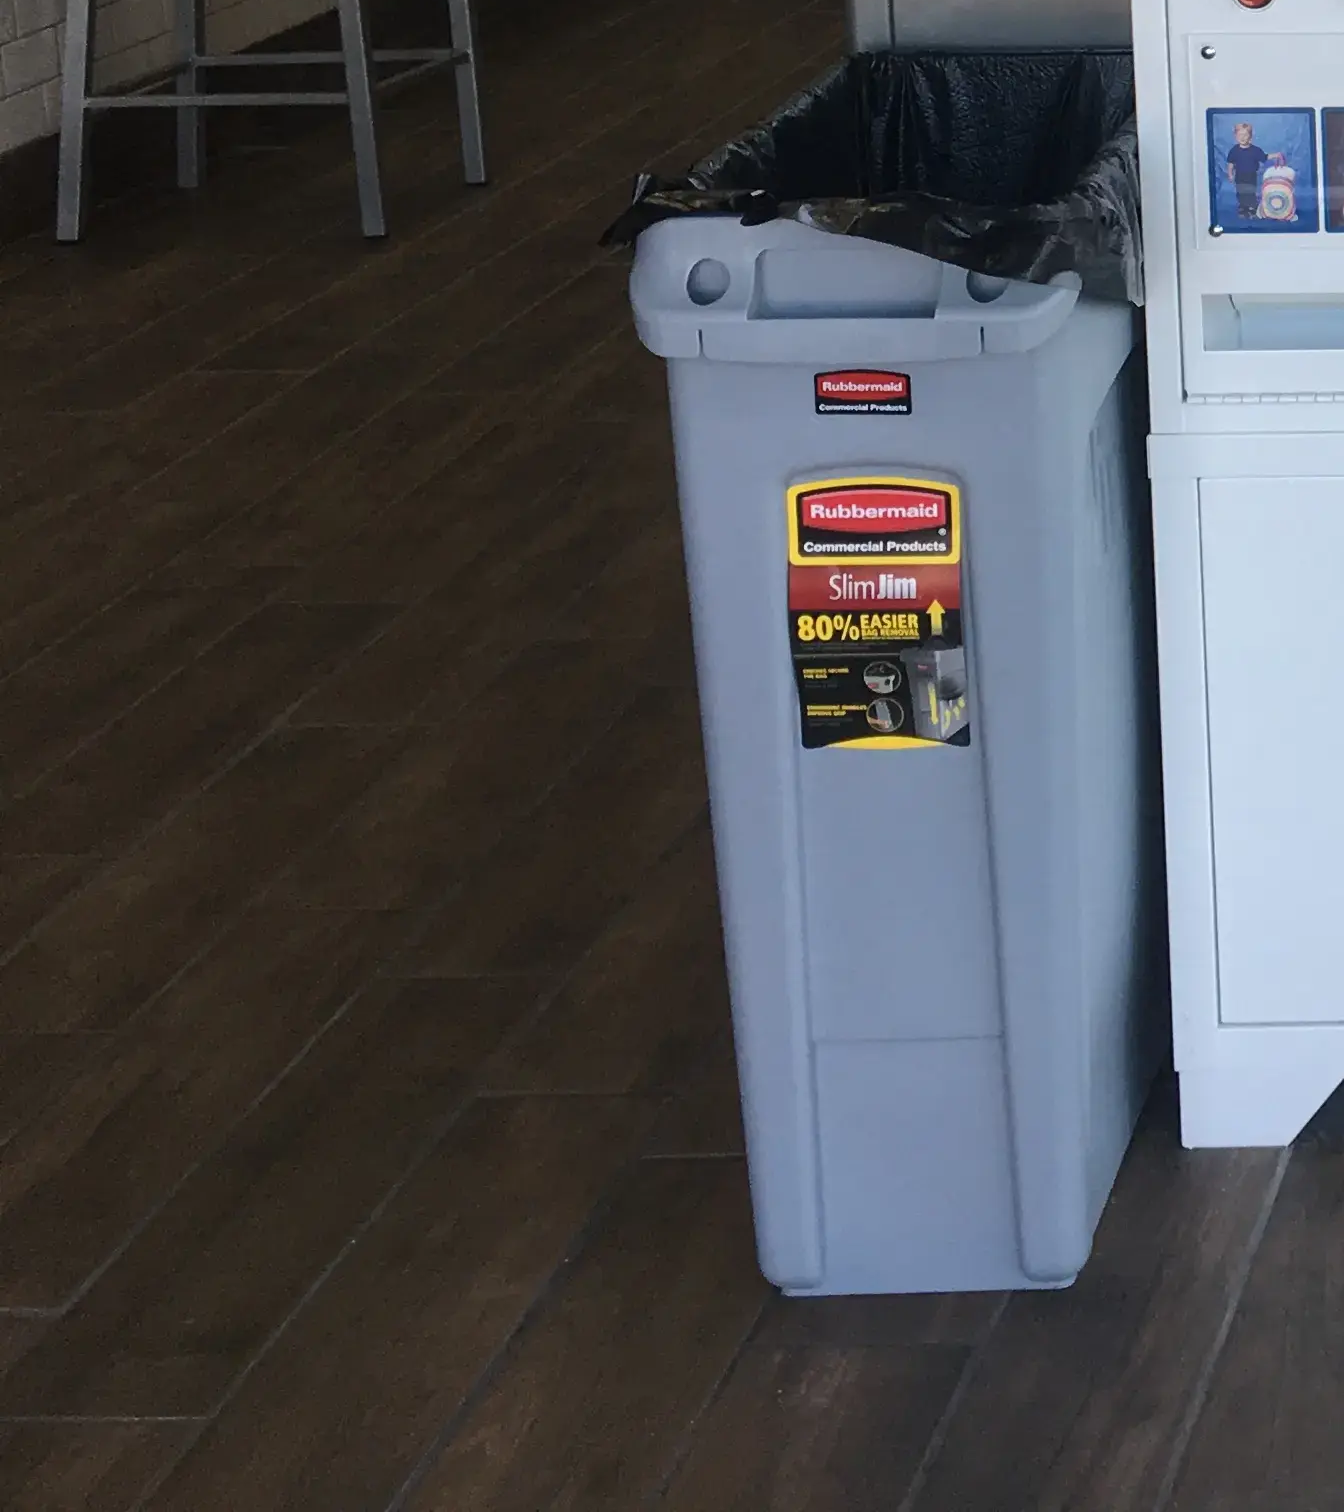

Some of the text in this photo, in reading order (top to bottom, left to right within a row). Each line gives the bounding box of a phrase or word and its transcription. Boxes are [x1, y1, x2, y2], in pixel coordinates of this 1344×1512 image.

[822, 381, 903, 392] Rubbermaid
[818, 403, 908, 412] Commercial Products
[810, 502, 938, 519] Rubbermaid
[803, 541, 947, 553] Commercial Products
[797, 613, 919, 641] 80% EASIER
[879, 628, 920, 637] REMOVAL
